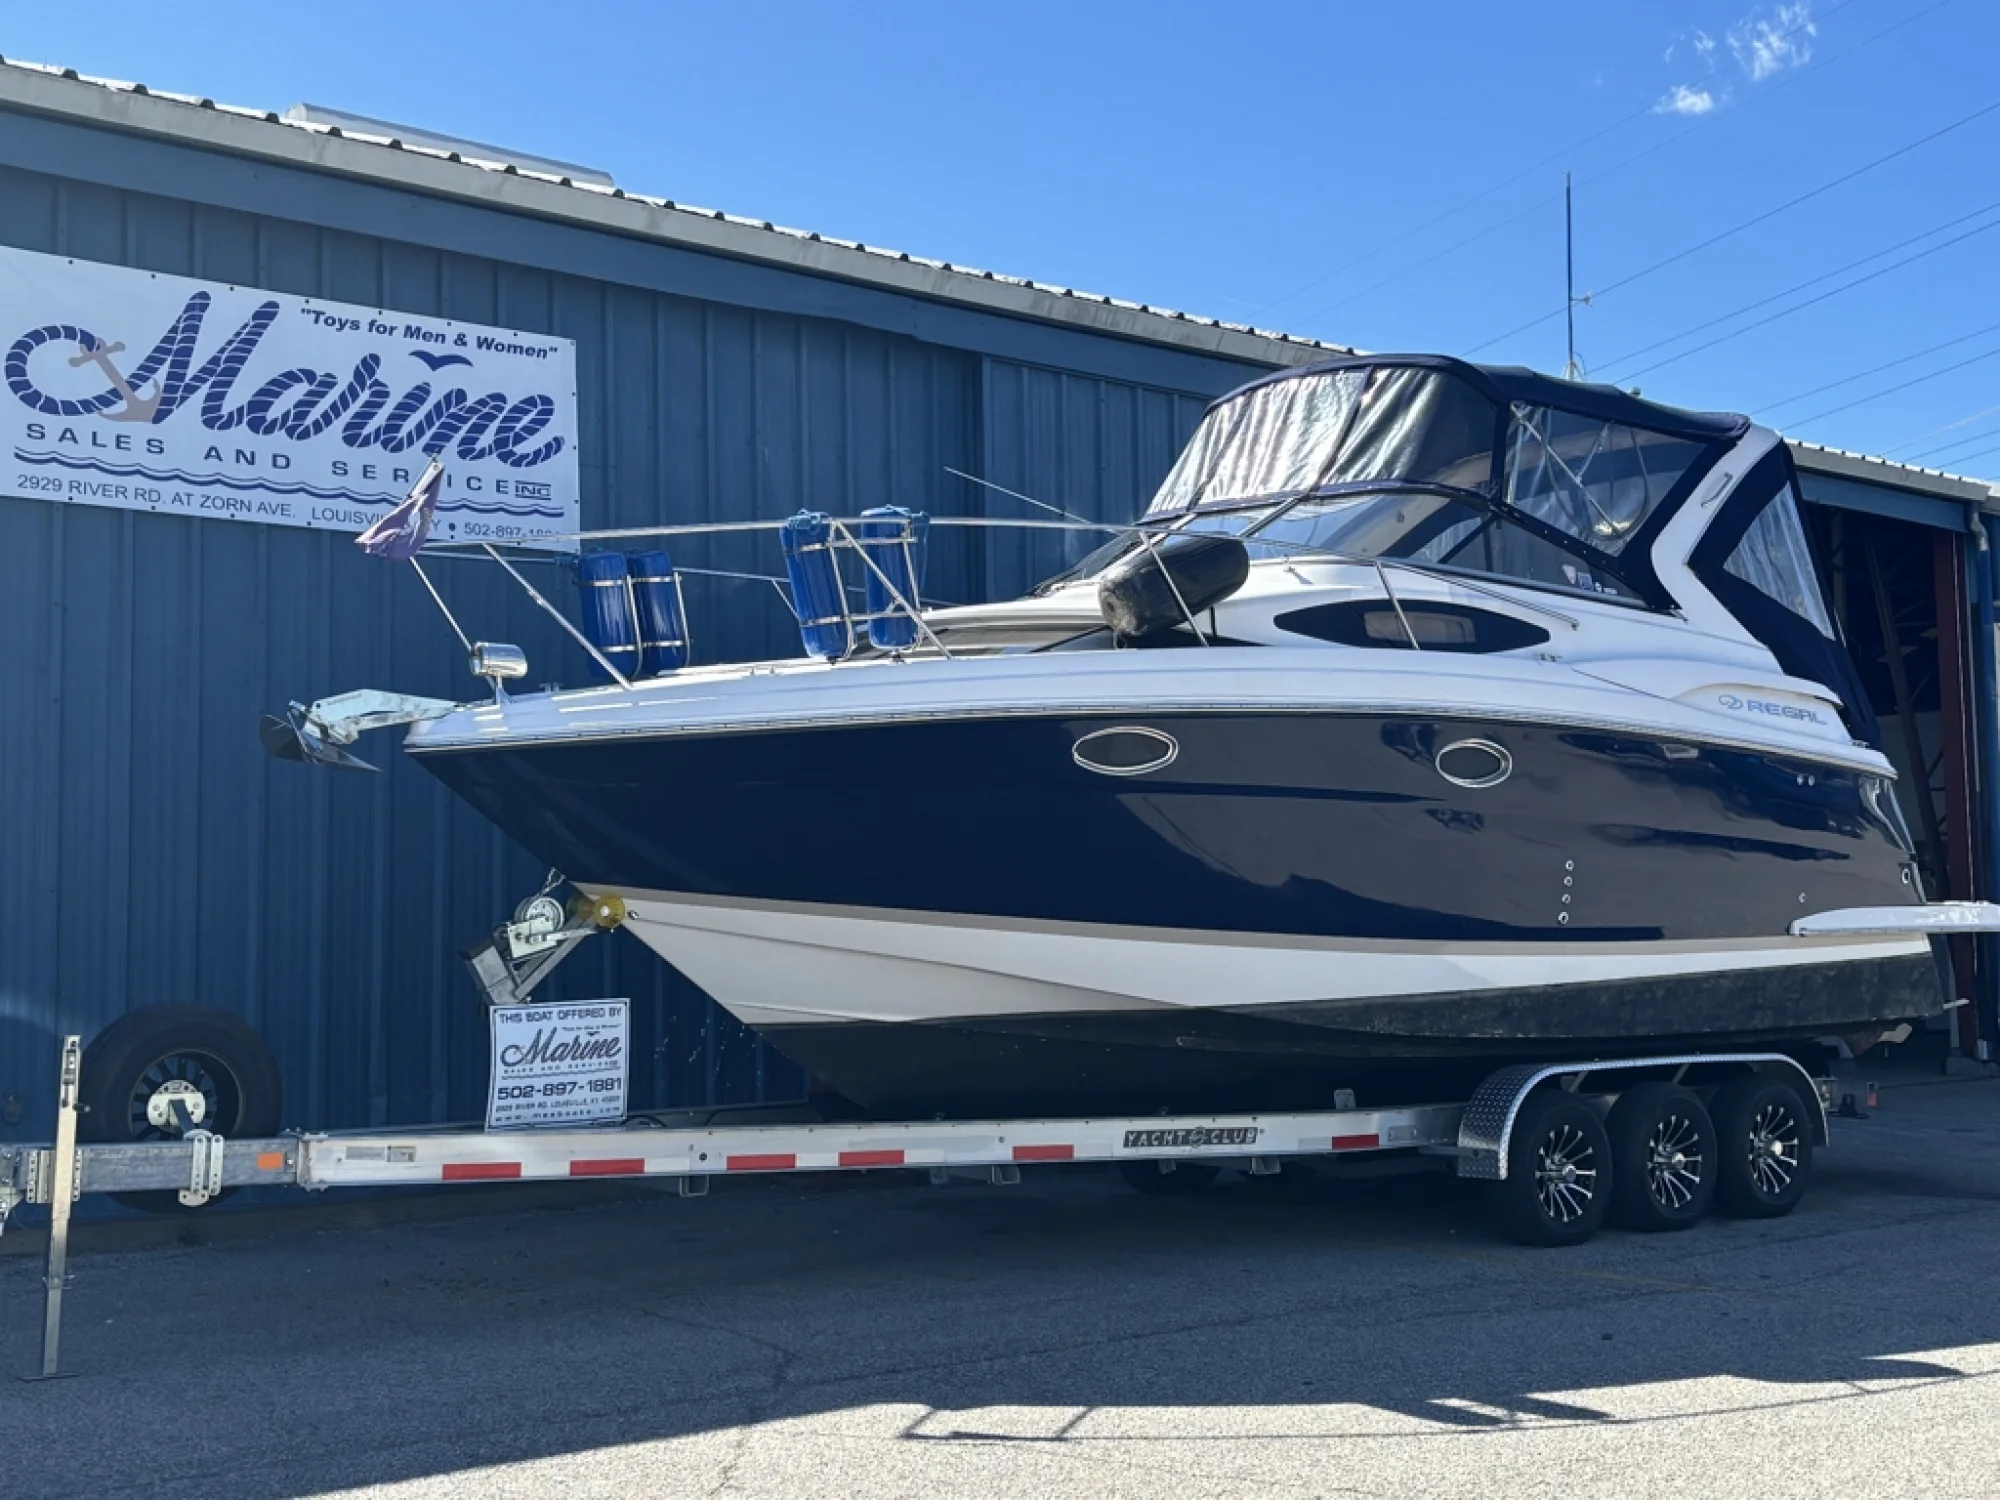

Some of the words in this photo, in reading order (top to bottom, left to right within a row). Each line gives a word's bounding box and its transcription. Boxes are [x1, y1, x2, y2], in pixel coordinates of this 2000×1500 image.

[301, 307, 361, 332] "Toys
[368, 319, 398, 337] for
[404, 325, 446, 344] Men
[453, 333, 469, 347] &
[476, 336, 558, 360] Women"
[4, 290, 565, 468] Marine
[26, 423, 165, 454] SALES
[204, 446, 291, 470] AND
[332, 461, 508, 494] SERICE
[515, 484, 551, 497] INC
[17, 474, 62, 493] 2929
[68, 480, 128, 499] RIVER
[134, 488, 166, 504] RD.
[171, 491, 194, 507] AT
[200, 496, 251, 513] ZORN
[256, 503, 296, 519] AVE.
[1747, 700, 1828, 726] REGAL
[500, 1013, 522, 1024] THIS
[526, 1011, 553, 1023] BOAT
[556, 1008, 606, 1020] OFFERED
[609, 1007, 622, 1017] BY
[500, 1027, 622, 1067] Marine
[497, 1078, 622, 1100] 502-897-1881
[1127, 1130, 1187, 1147] YACHT
[1210, 1128, 1256, 1144] CLUB
